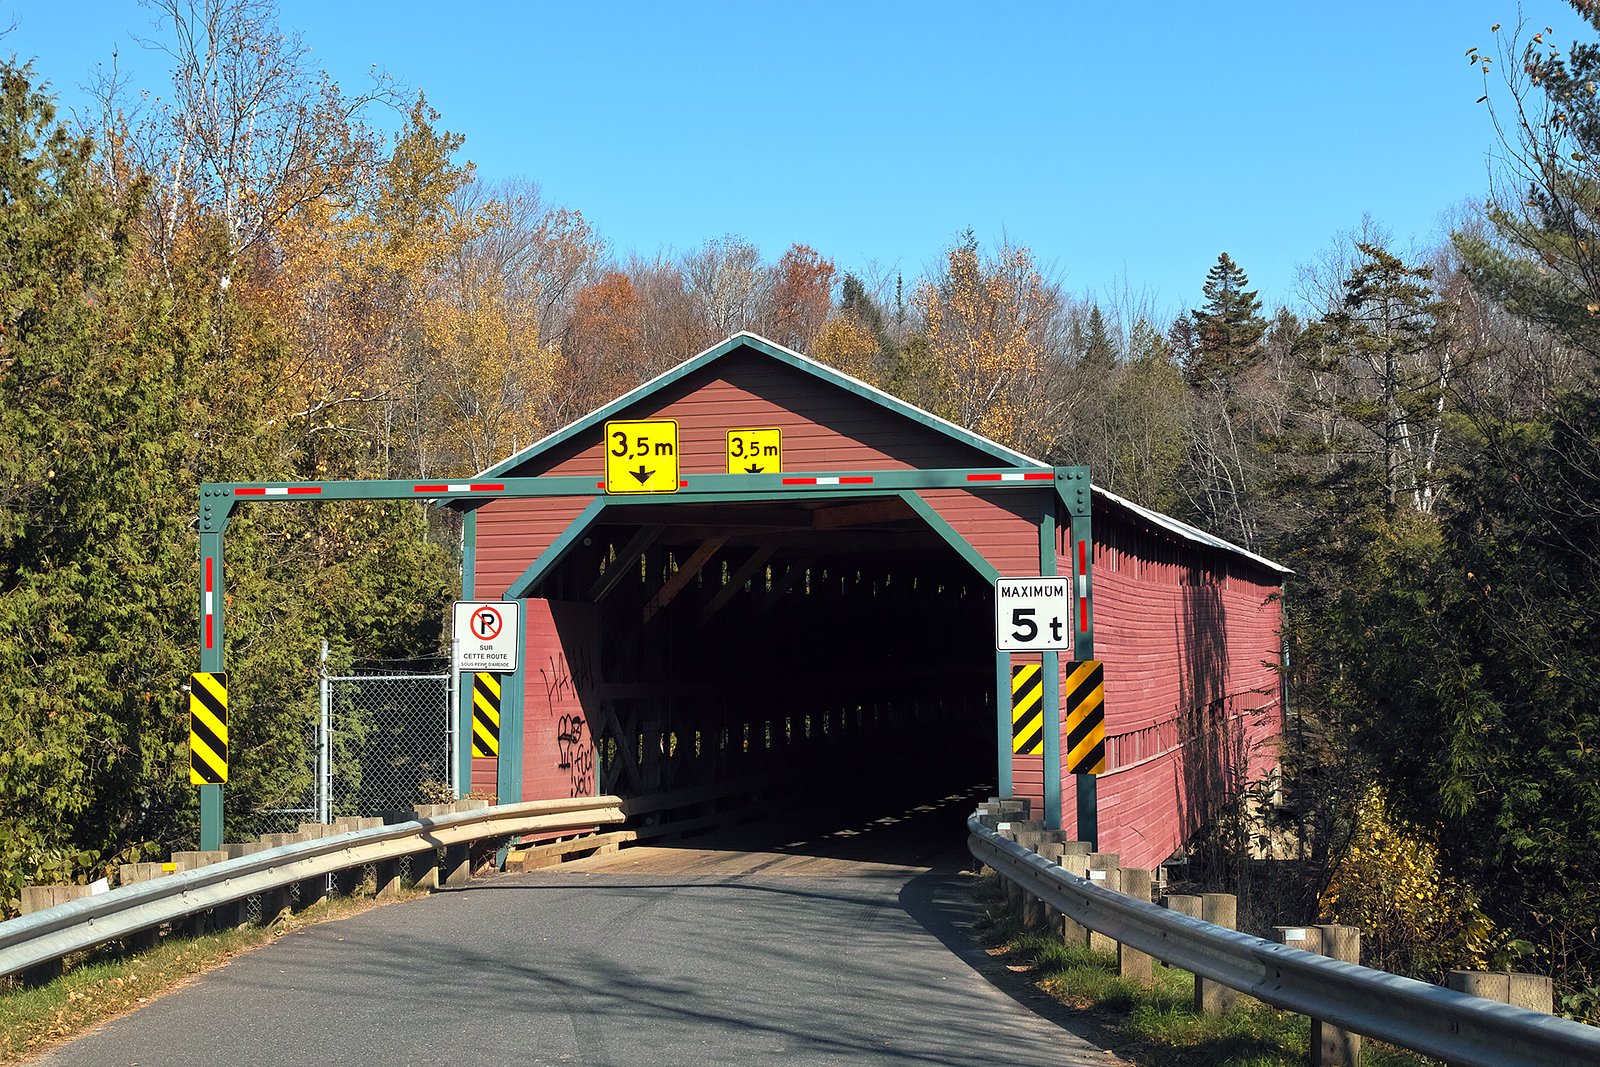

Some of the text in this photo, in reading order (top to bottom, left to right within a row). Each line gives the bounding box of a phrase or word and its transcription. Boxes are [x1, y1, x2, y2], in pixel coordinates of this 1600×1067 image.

[611, 431, 674, 460] 3,5 m
[730, 437, 778, 460] 3,5 m
[1001, 585, 1064, 598] MAXIMUM
[481, 613, 495, 635] P
[1011, 608, 1063, 642] 5 t
